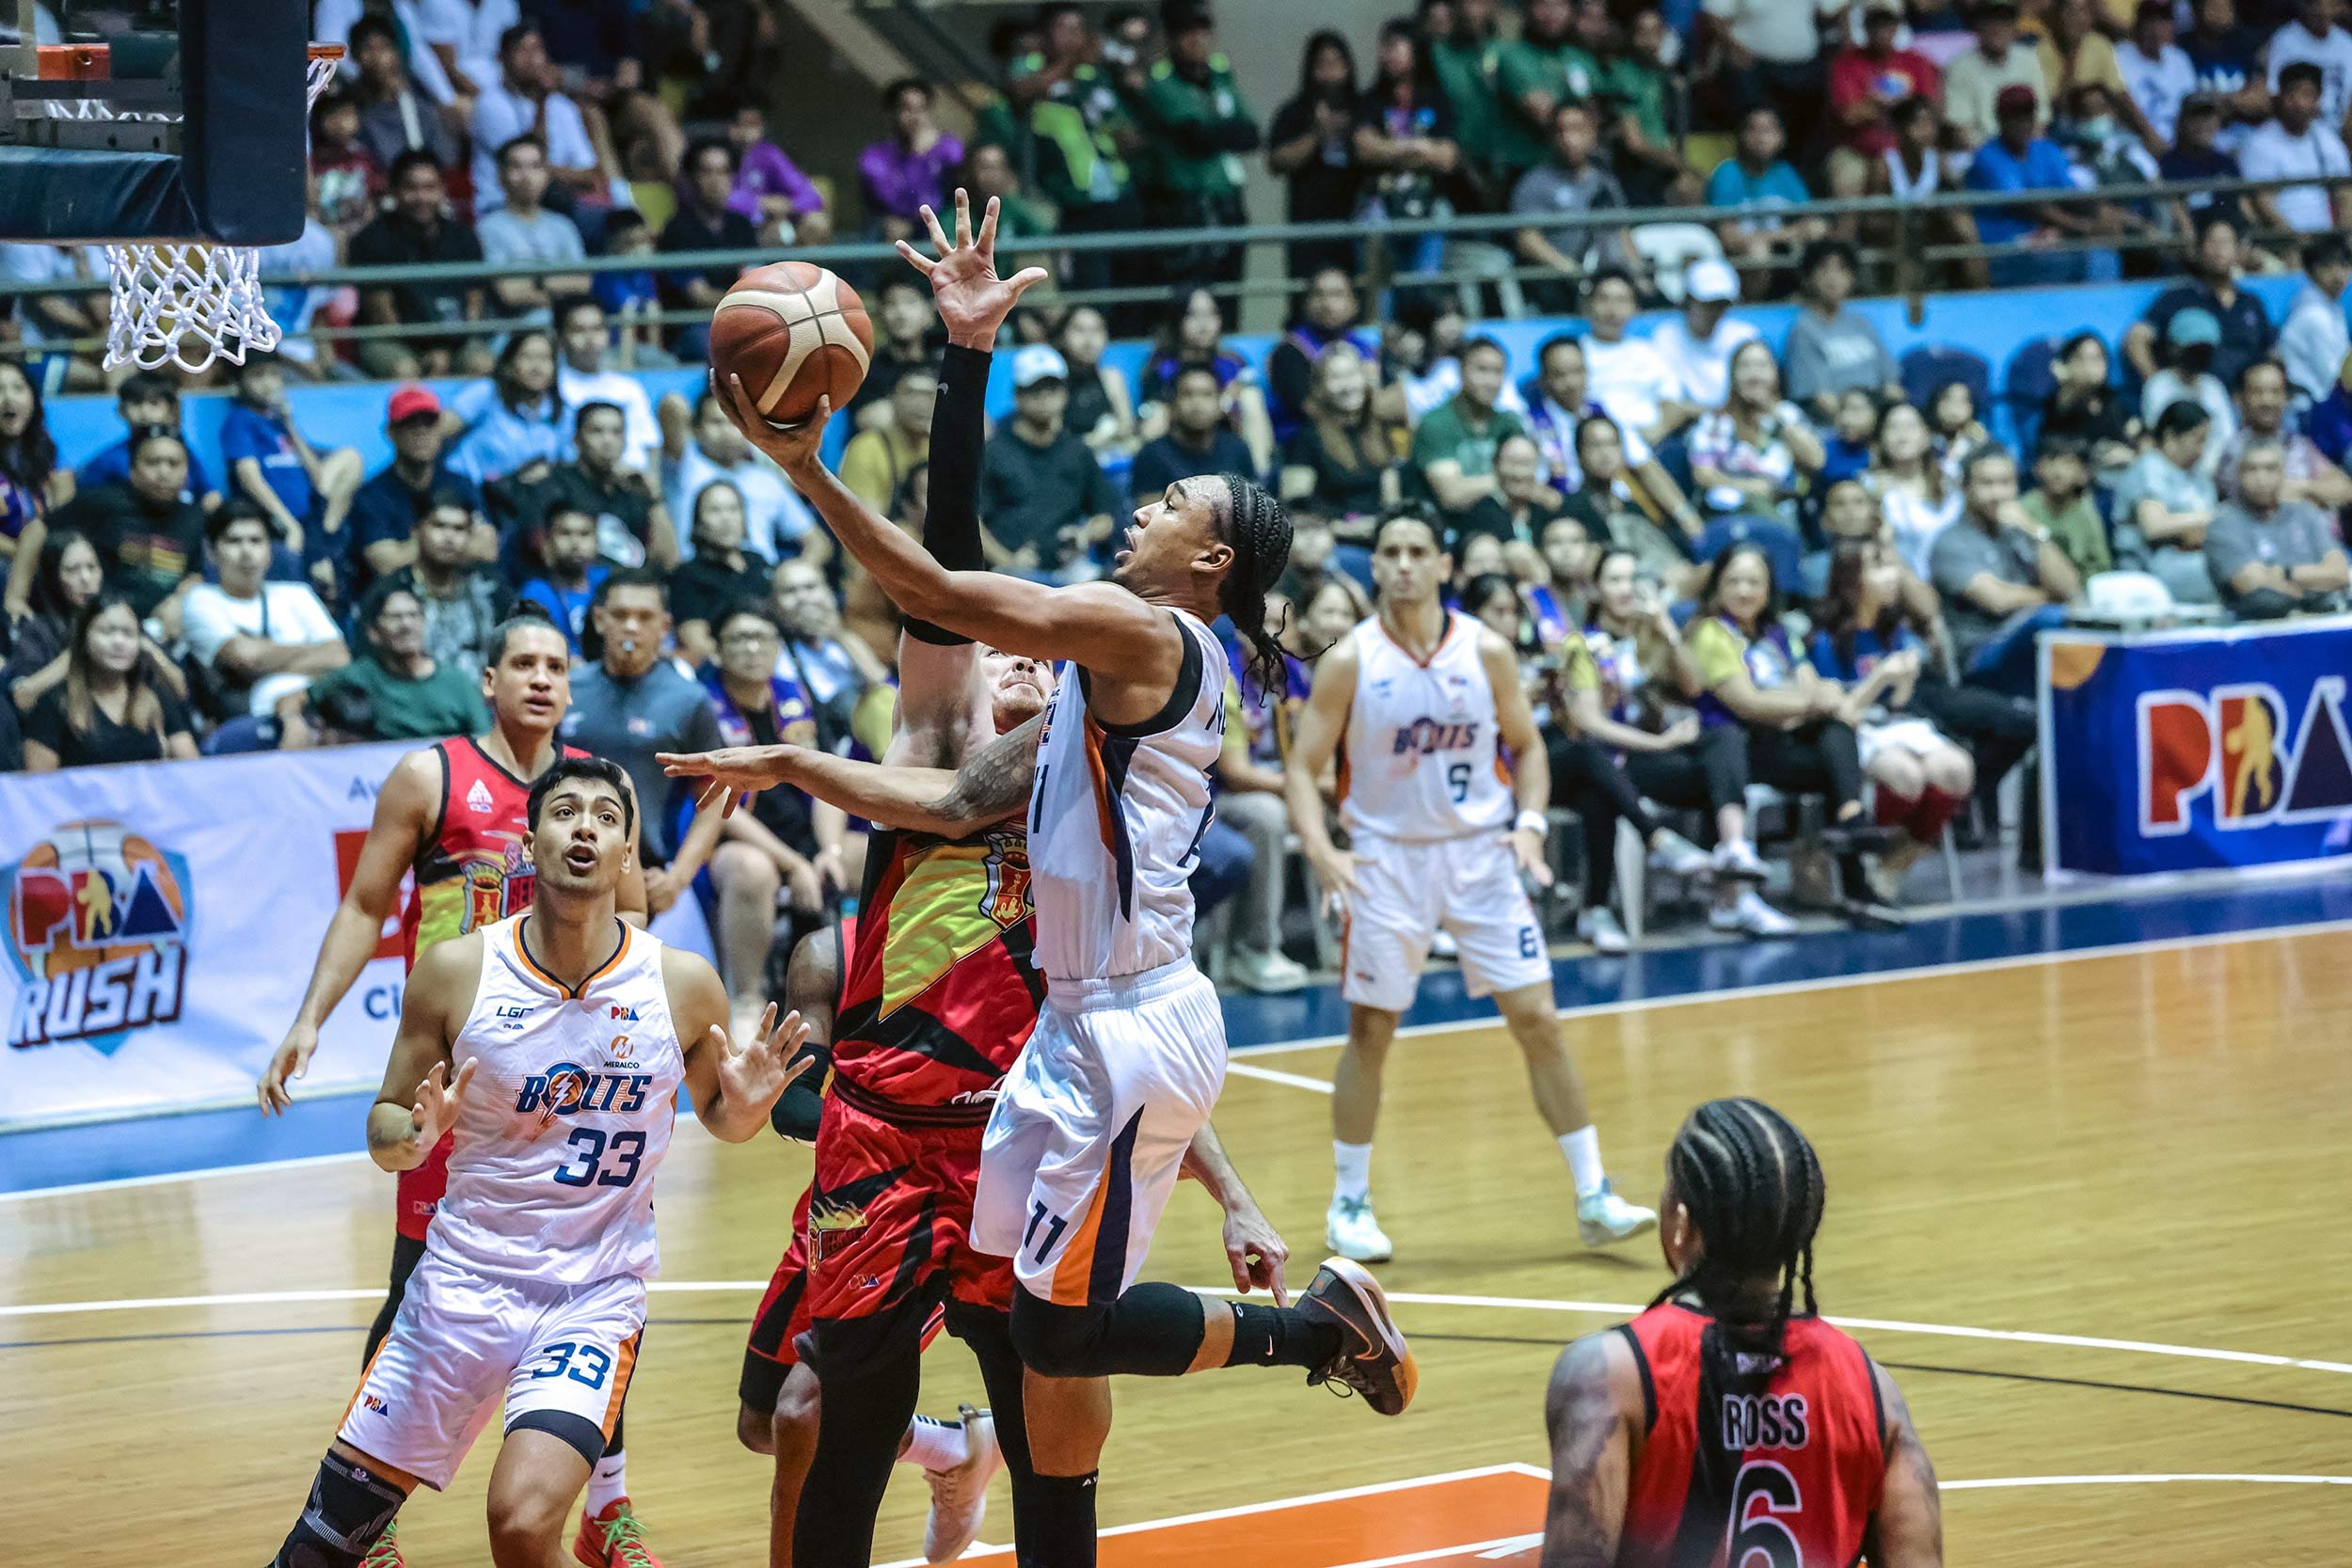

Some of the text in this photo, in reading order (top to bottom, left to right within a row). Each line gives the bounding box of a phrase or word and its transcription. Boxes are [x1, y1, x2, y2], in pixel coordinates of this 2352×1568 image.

[2137, 675, 2352, 837] PBA
[16, 860, 183, 951] PBA
[8, 942, 187, 1050] RUSH
[611, 1006, 640, 1022] PBA
[516, 1060, 655, 1119] BOLTS
[603, 1060, 640, 1069] MERALCO
[553, 1127, 647, 1188] 33
[1024, 1199, 1069, 1265] 11
[531, 1341, 612, 1390] 33
[363, 1394, 389, 1417] PBA
[1723, 1392, 1809, 1451] ROSS
[1726, 1459, 1804, 1568] 6
